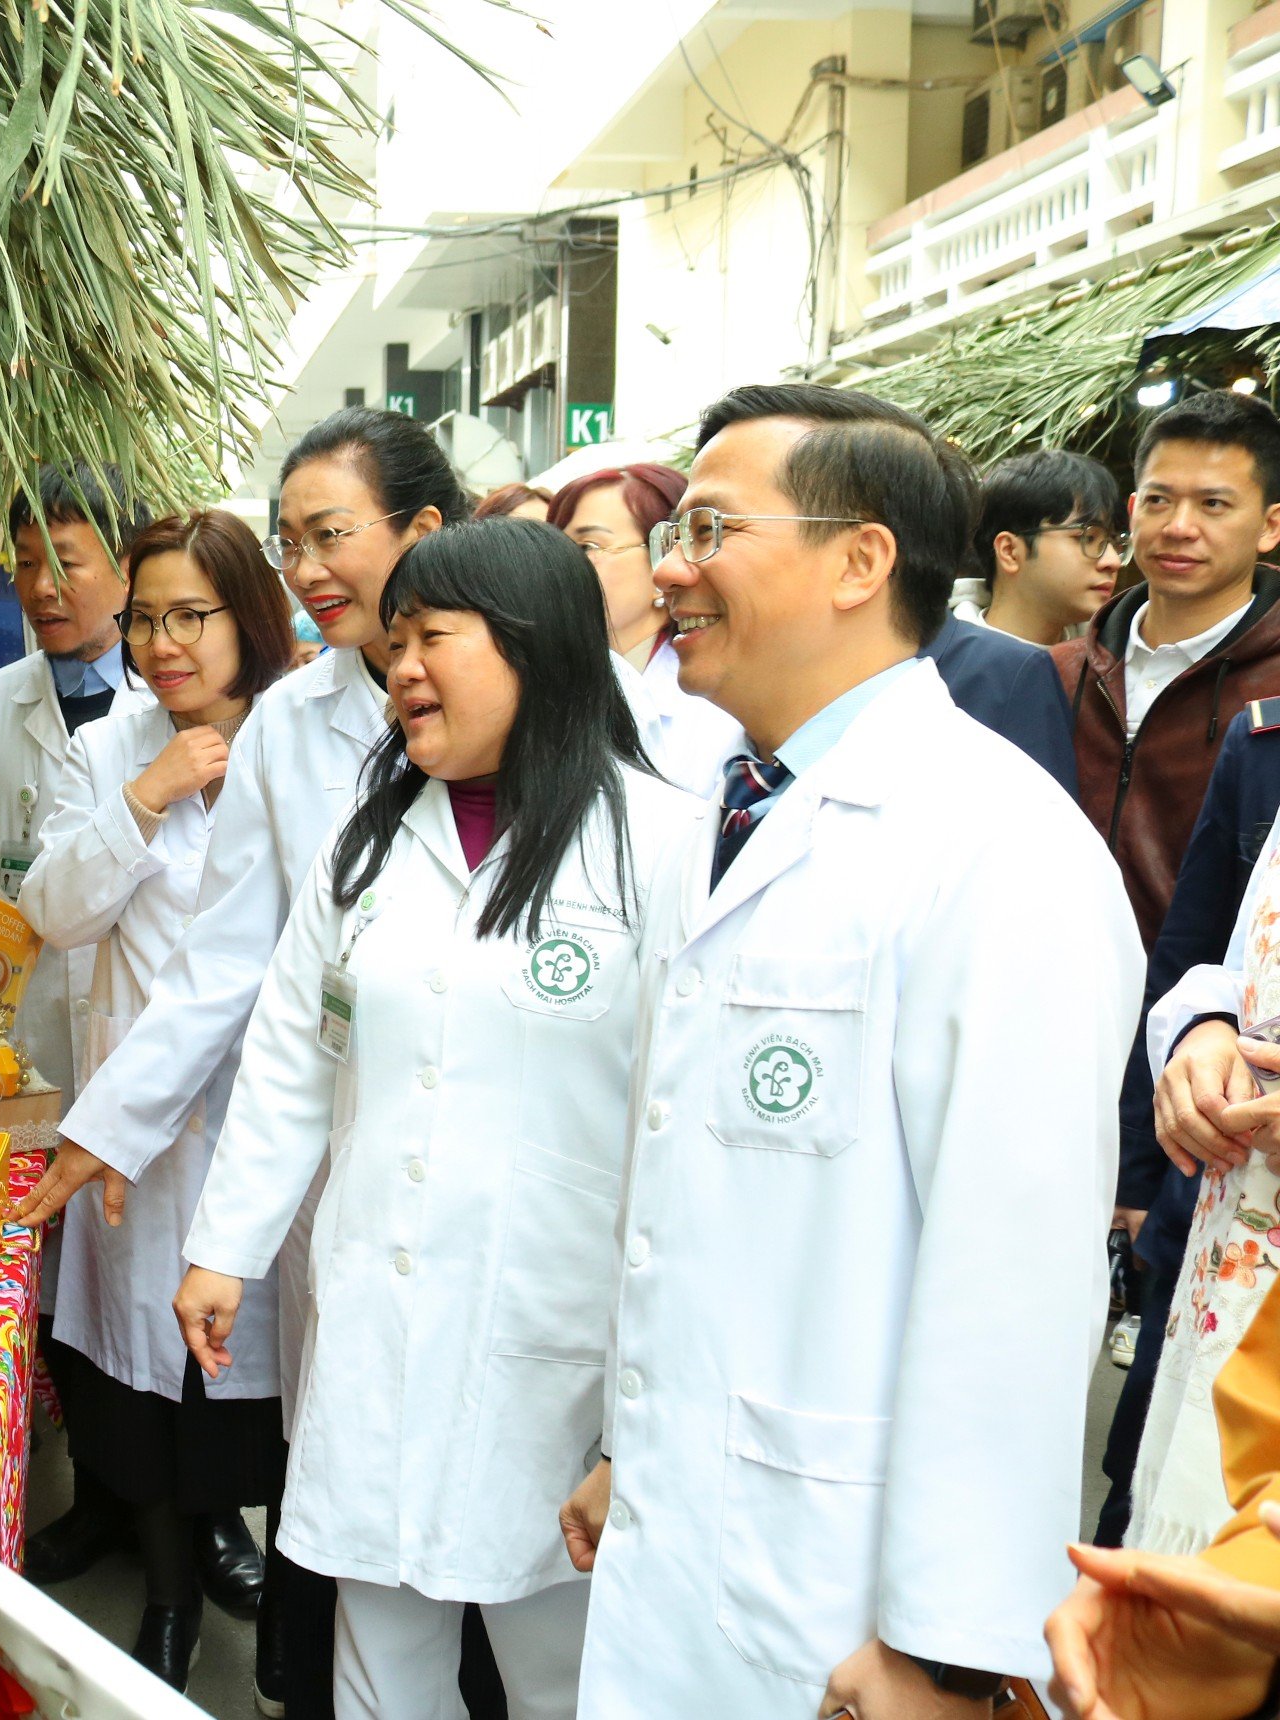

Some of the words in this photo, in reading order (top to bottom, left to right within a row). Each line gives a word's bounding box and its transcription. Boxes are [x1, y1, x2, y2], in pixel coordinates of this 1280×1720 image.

[389, 395, 415, 417] K1
[571, 409, 609, 443] K1
[591, 952, 600, 971] MAI
[535, 990, 552, 1004] MAI
[554, 984, 594, 1006] HOSPITAL
[811, 1056, 824, 1078] MAI
[756, 1110, 775, 1124] MAI
[777, 1095, 820, 1125] HOSPITAL
